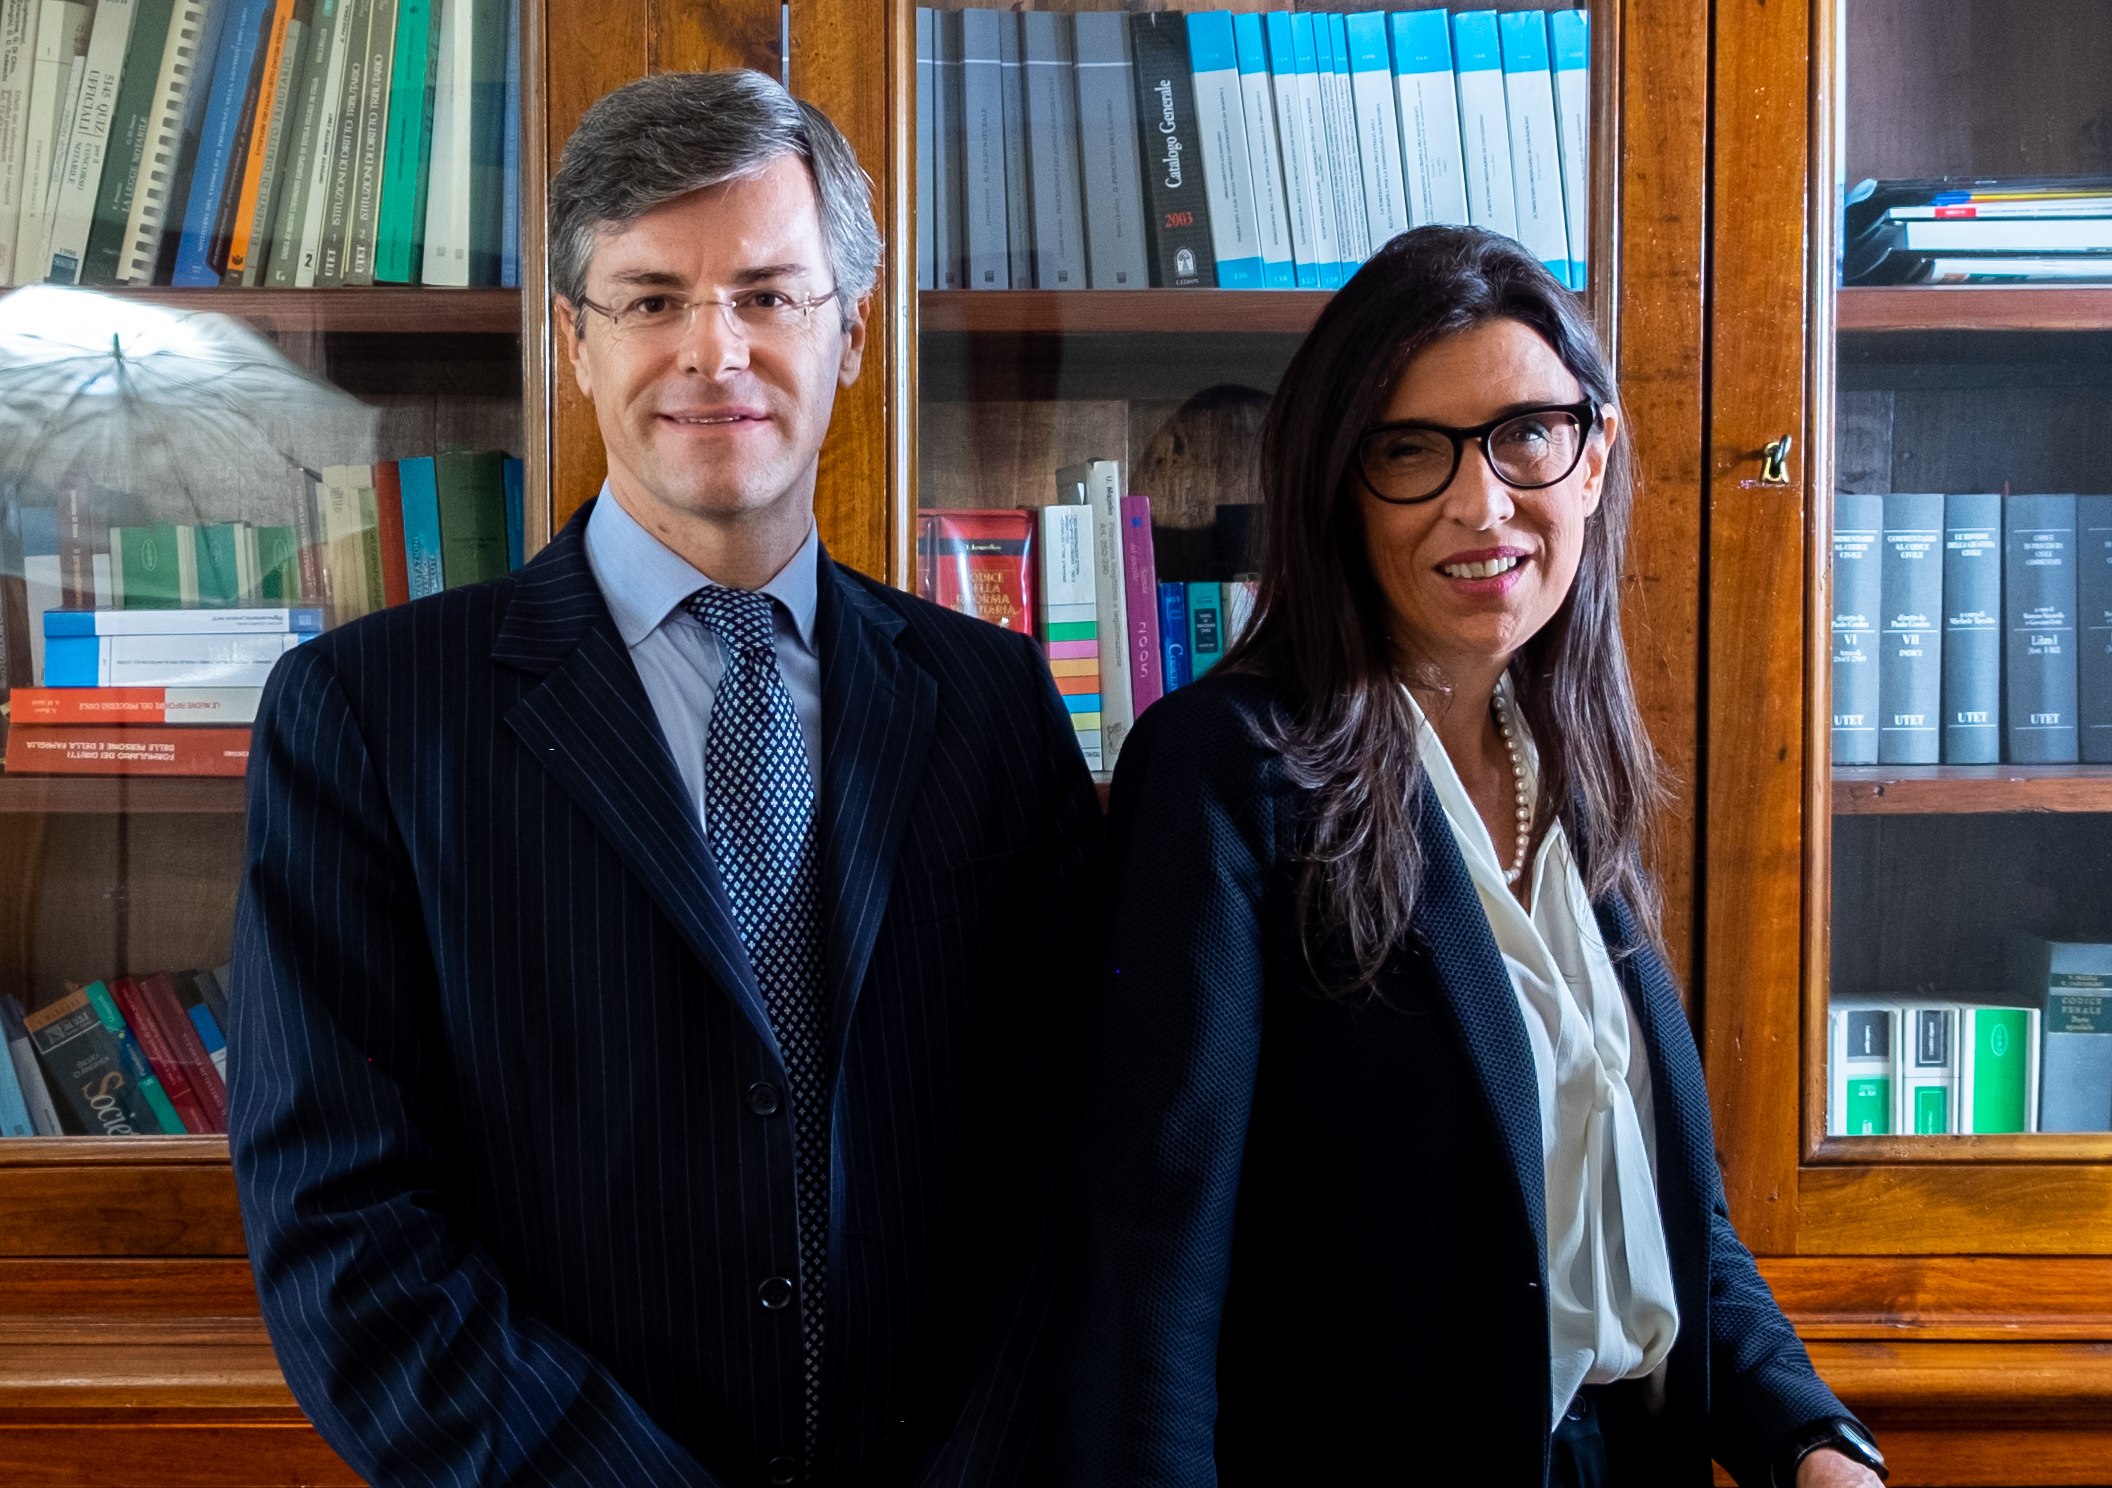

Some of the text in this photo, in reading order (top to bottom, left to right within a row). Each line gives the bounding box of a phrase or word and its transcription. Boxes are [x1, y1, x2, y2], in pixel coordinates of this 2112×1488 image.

[345, 61, 361, 116] TRIBUTARIO
[368, 52, 384, 109] TRIBUTARIO
[77, 69, 99, 132] UFFICIALI
[91, 73, 114, 134] 5145 QUIZ
[126, 114, 153, 163] NOTARILE
[339, 119, 353, 158] DIRITTO
[365, 111, 378, 150] DIRITTO
[1154, 79, 1183, 189] Catalogo Generale
[248, 55, 296, 247] ELEMENTI DI DIRITTO TRIBUTARIO
[364, 151, 374, 163] DI
[75, 142, 92, 191] CONCORSO
[120, 164, 141, 197] LEGGE
[331, 170, 347, 225] ISTITUZIONI
[358, 163, 374, 220] ISTITUZIONI
[1165, 211, 1195, 229] 2003
[303, 252, 313, 269] 2
[324, 248, 336, 276] UTET
[354, 244, 366, 273] UTET
[409, 534, 426, 596] ALUTAZIONE
[1843, 633, 1858, 645] VI
[1902, 633, 1920, 645] VII
[1833, 714, 1864, 726] UTET
[1893, 714, 1925, 726] UTET
[1957, 711, 1988, 723] UTET
[2030, 713, 2060, 724] UTET
[65, 750, 98, 759] DIRITTI
[68, 741, 96, 749] DELLA
[2061, 996, 2102, 1005] CODICE
[2061, 1006, 2102, 1015] PENALE
